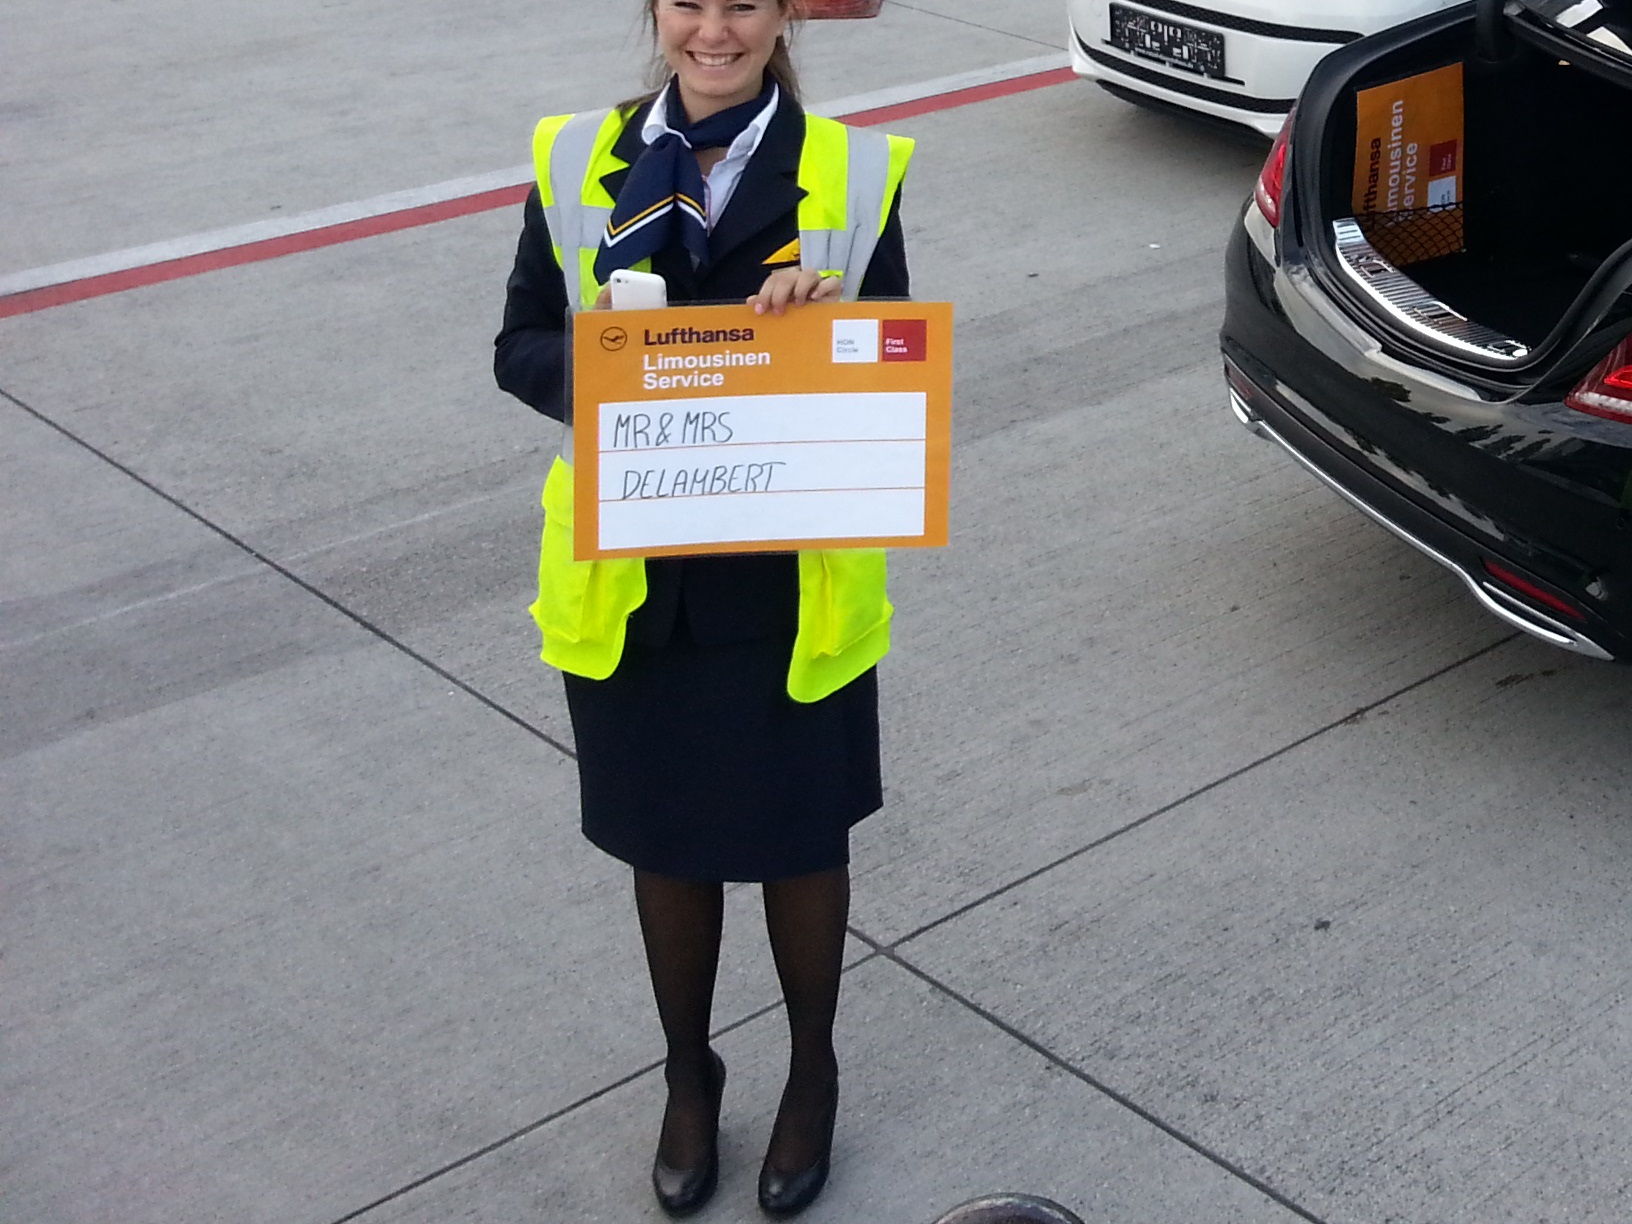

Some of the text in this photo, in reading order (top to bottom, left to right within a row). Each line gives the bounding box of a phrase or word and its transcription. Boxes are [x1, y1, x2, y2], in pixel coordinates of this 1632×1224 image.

[1362, 138, 1381, 221] fthansa
[643, 326, 755, 347] Lufthansa
[885, 337, 904, 346] First
[643, 349, 771, 372] Limousinen
[885, 345, 908, 354] Class
[643, 371, 725, 391] Service
[681, 411, 734, 444] MRS
[621, 461, 787, 501] DELAMBERT
